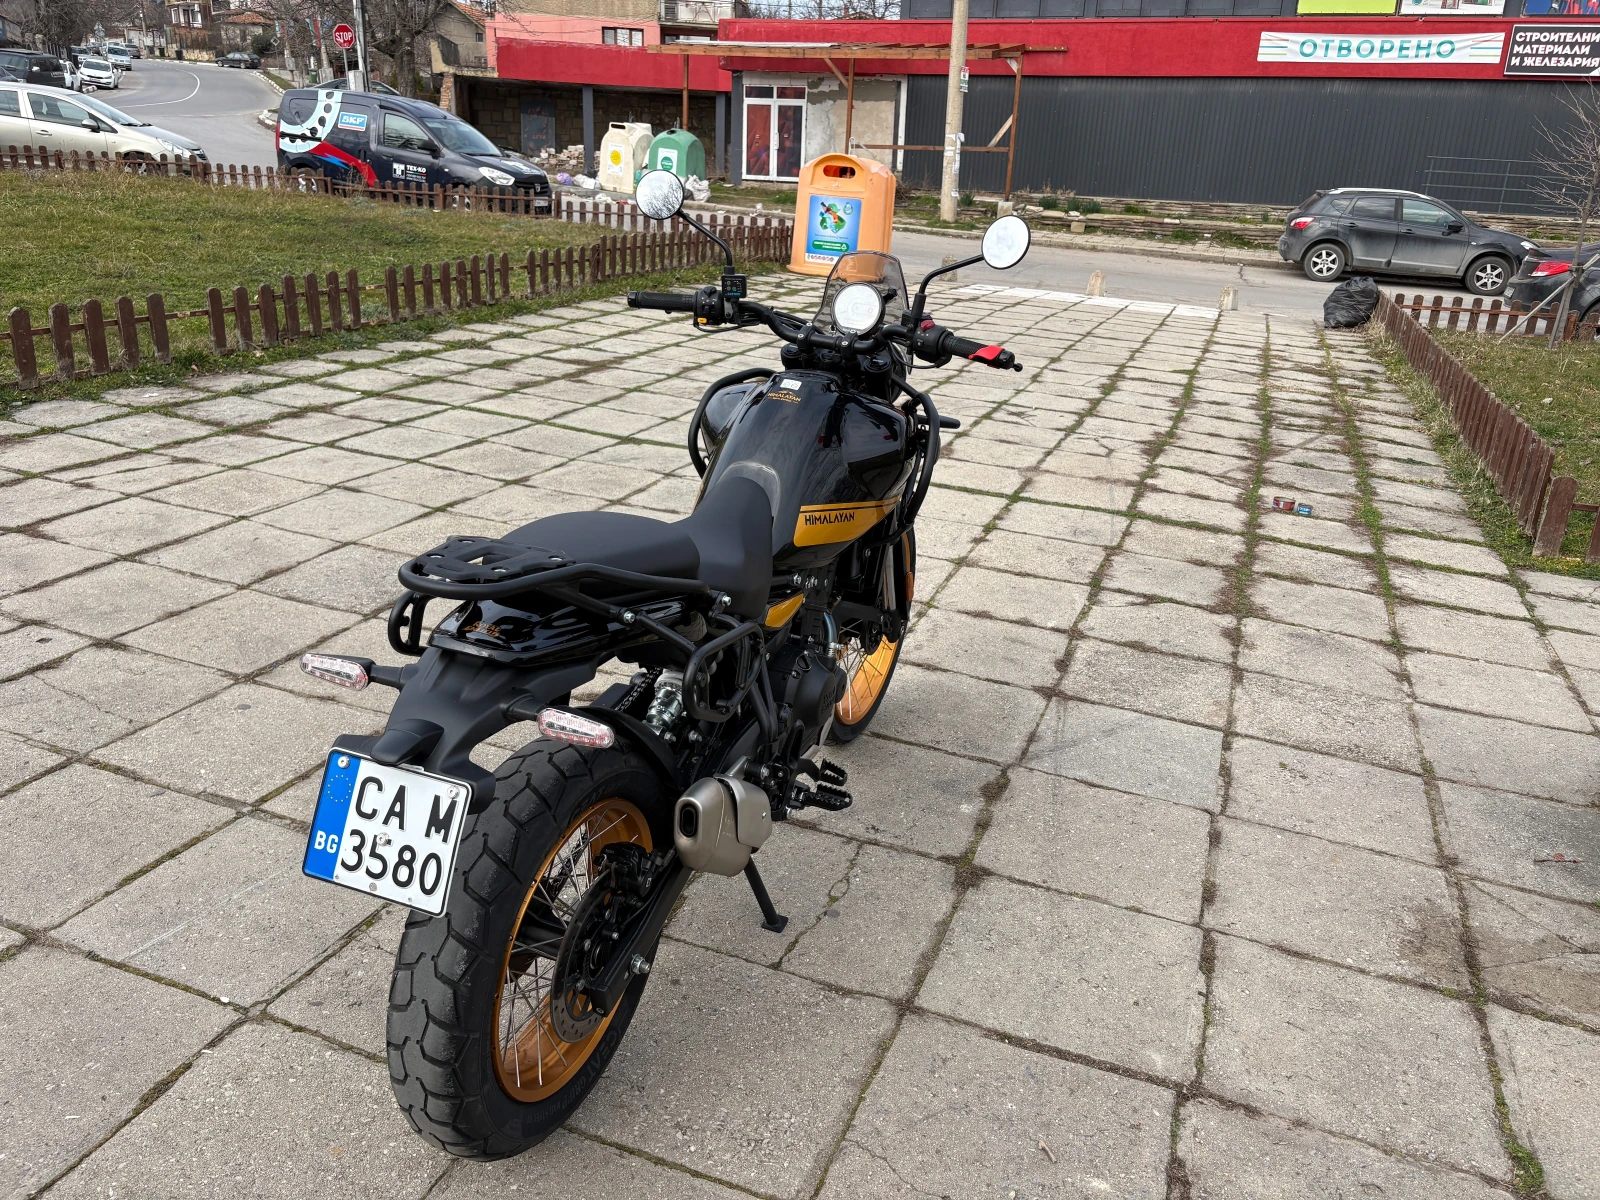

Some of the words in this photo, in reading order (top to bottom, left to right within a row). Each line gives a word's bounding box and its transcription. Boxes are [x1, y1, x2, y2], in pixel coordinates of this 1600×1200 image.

[335, 31, 353, 42] STOP
[1515, 31, 1600, 43] СТРОИТЕЛНИ
[1299, 39, 1456, 59] ОТВОРЕНО
[1512, 44, 1591, 55] МАТЕРИАЛИ
[1510, 56, 1521, 67] И
[1521, 56, 1600, 68] ЖЕЛЕЗАРИЯ
[341, 115, 365, 125] SKF
[804, 511, 855, 526] HIMALAYAN
[355, 775, 406, 831] CA
[424, 794, 458, 844] M
[314, 830, 339, 854] BG
[340, 828, 443, 896] 3580
